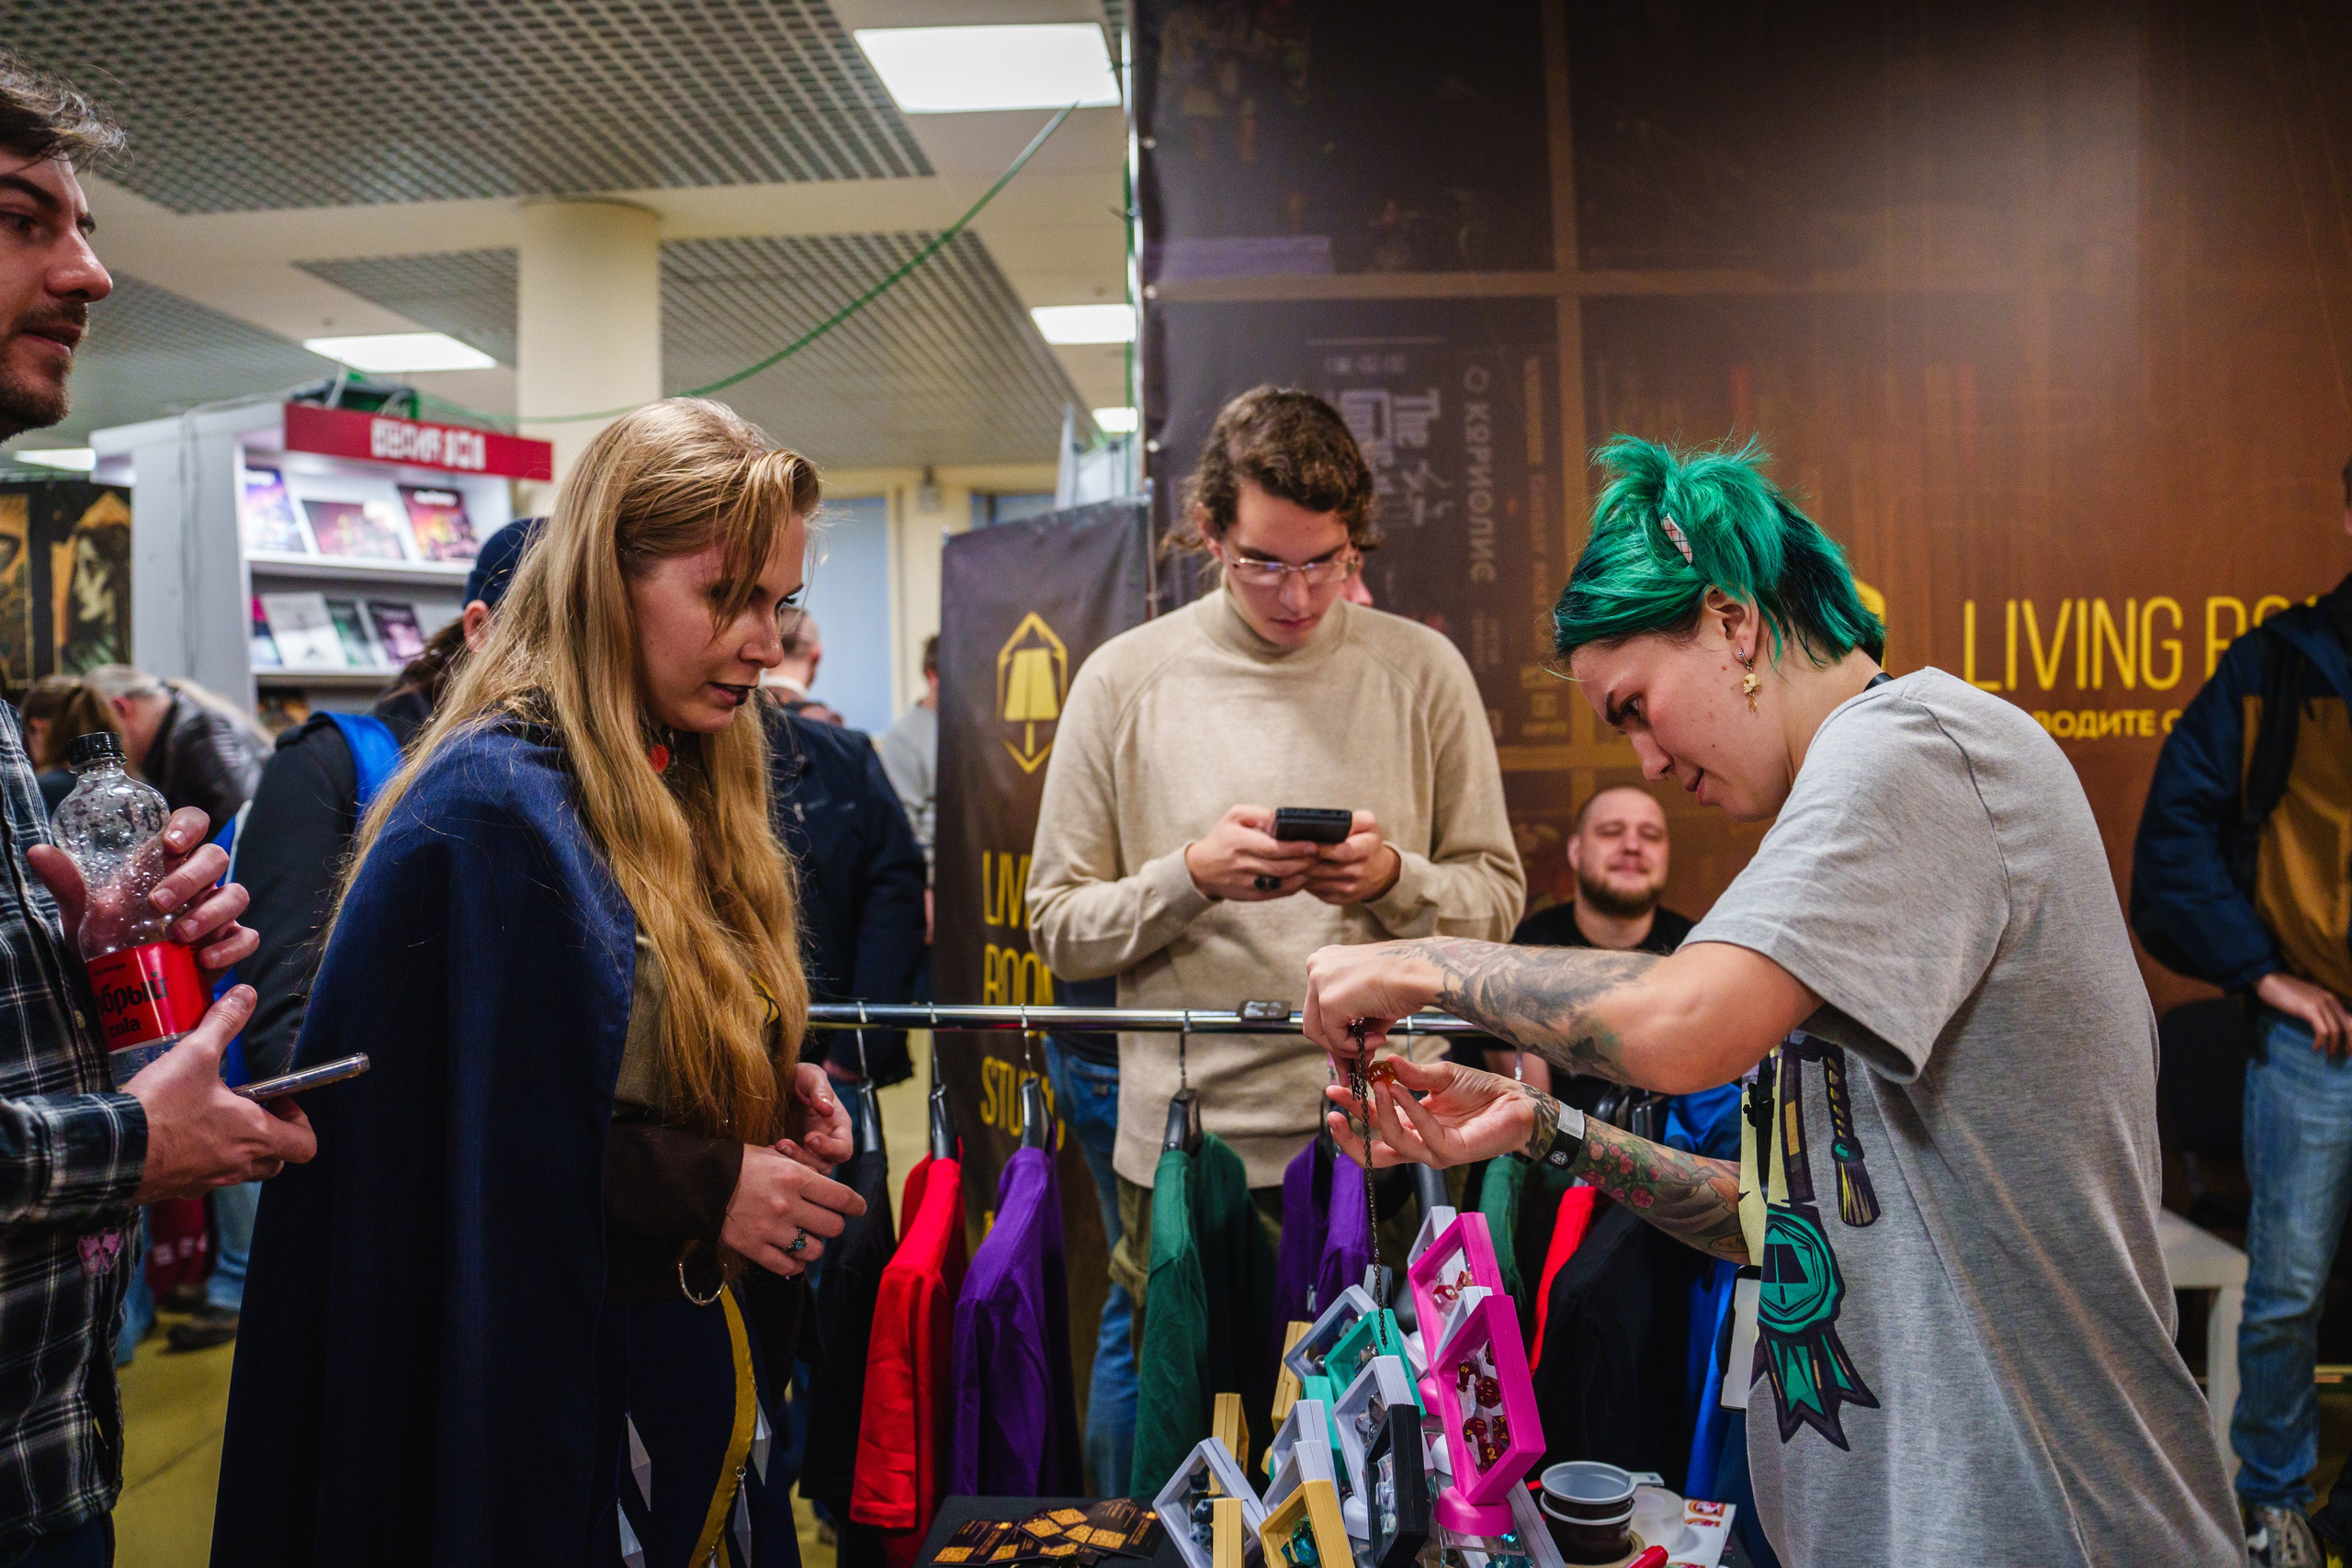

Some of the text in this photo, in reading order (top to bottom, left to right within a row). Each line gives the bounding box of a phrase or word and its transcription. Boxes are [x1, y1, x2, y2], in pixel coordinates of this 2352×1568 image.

[1962, 595, 2184, 693] LIVING
[982, 850, 1032, 931] LIV
[94, 970, 169, 1016] брый
[108, 1017, 141, 1038] cola
[979, 1056, 1066, 1152] STU
[1487, 1447, 1498, 1460] 2
